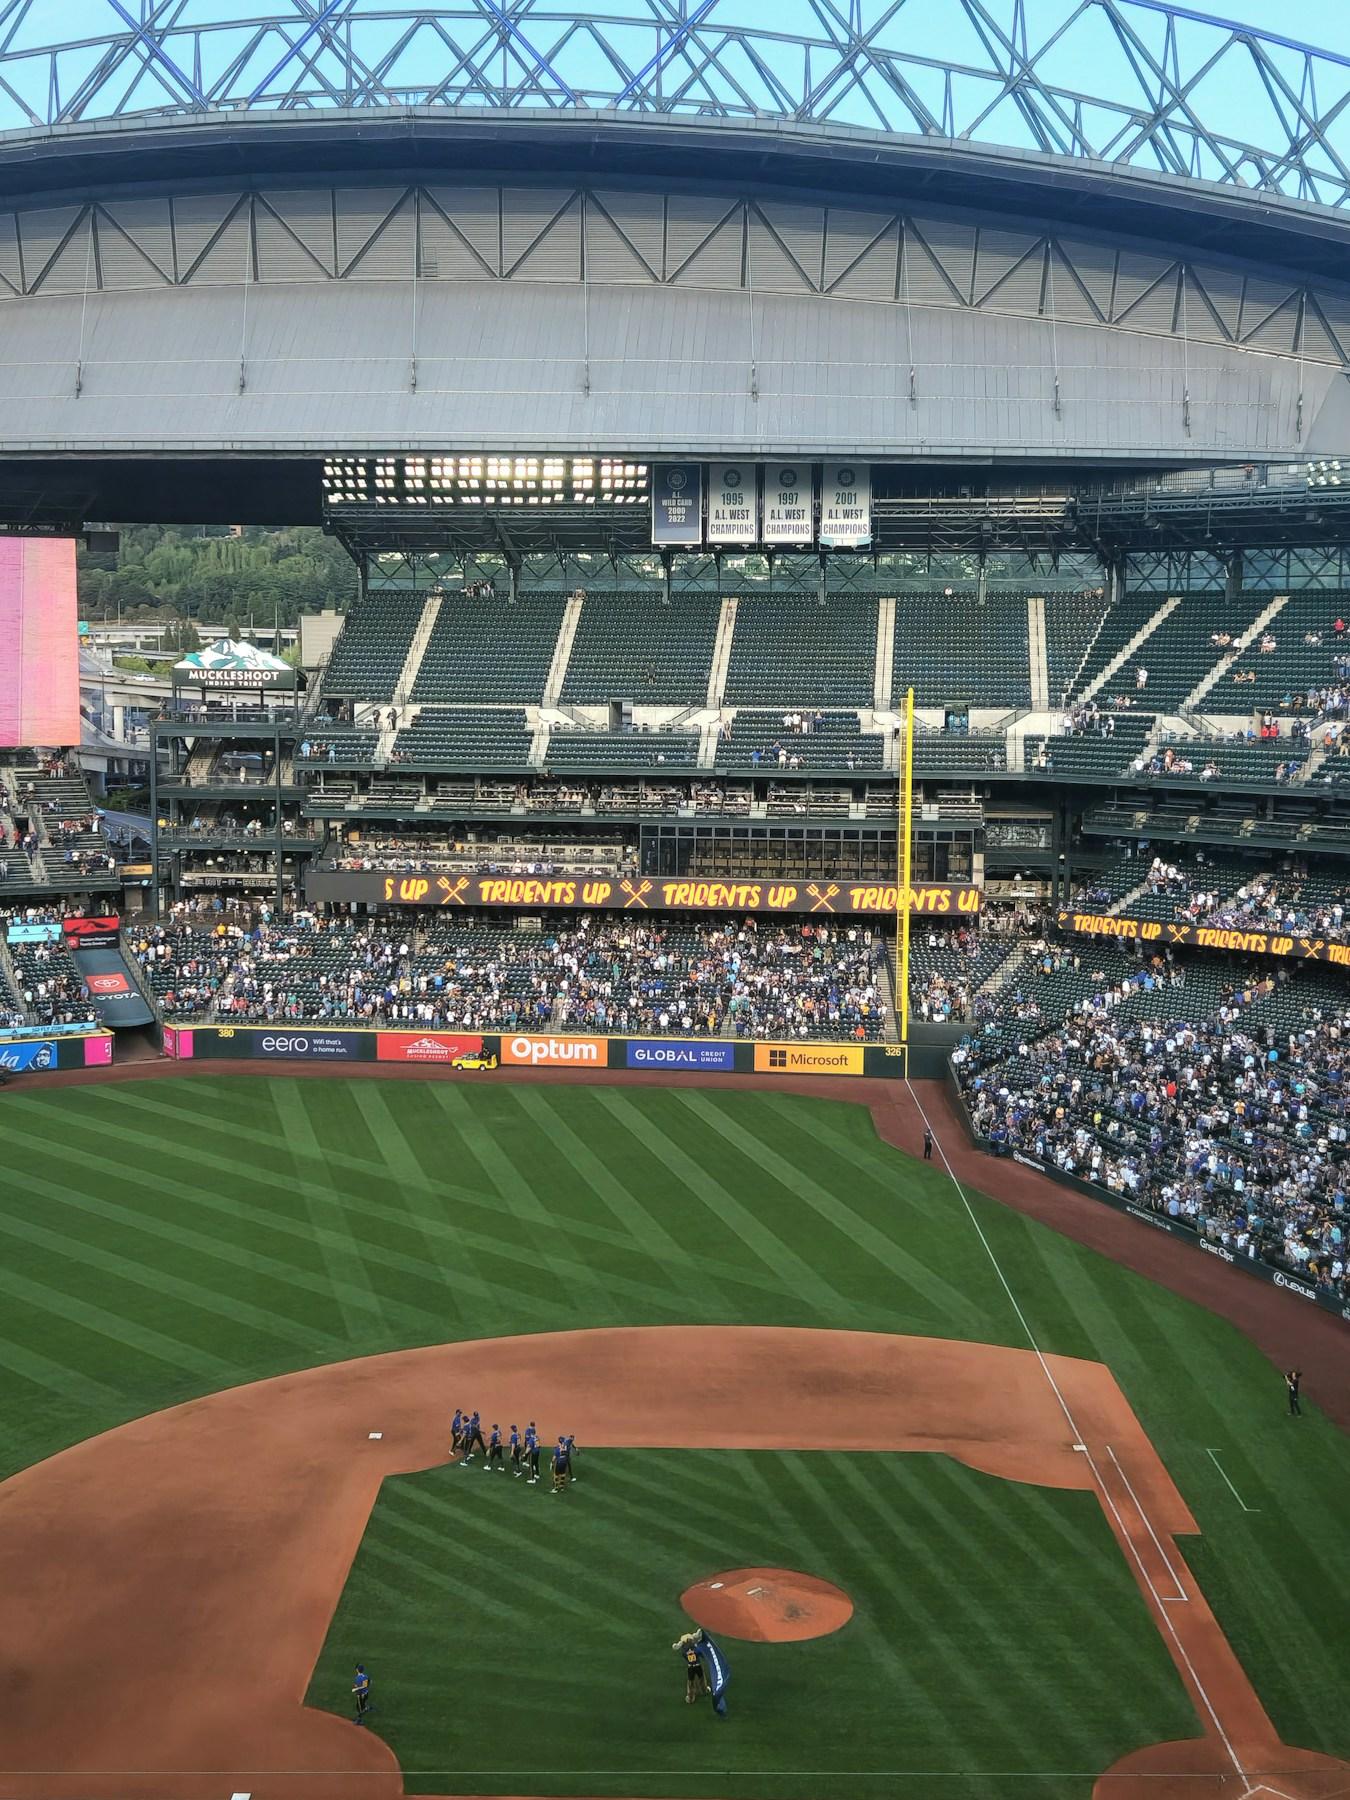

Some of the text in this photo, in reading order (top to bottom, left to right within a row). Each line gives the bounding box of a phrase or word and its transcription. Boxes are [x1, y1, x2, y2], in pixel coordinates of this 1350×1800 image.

[721, 492, 744, 505] 1995
[777, 492, 799, 505] 1997
[835, 492, 857, 505] 2001
[668, 514, 686, 523] 2022
[730, 509, 750, 520] WEST
[785, 509, 806, 520] WEST
[842, 509, 864, 520] WEST
[710, 523, 754, 535] CHAMPIONS
[766, 523, 810, 535] CHAMPIONS
[823, 523, 868, 535] CHAMPIONS
[188, 670, 279, 681] MUCKLESHOOT
[400, 879, 430, 902] UP
[480, 880, 611, 905] TRIDENTS UP
[662, 884, 797, 909] TRIDENTS UP
[1073, 914, 1162, 940] TRIDENTS UP
[1196, 928, 1294, 955] TRIDENTS UP
[218, 1029, 234, 1038] 380
[262, 1037, 309, 1052] eero
[511, 1037, 598, 1064] Optum
[407, 1048, 449, 1056] MUCKLESHOOT
[635, 1049, 697, 1061] GLOBAL
[884, 1047, 902, 1057] 326
[790, 1053, 849, 1067] Microsoft
[1285, 1279, 1316, 1300] LEXUS
